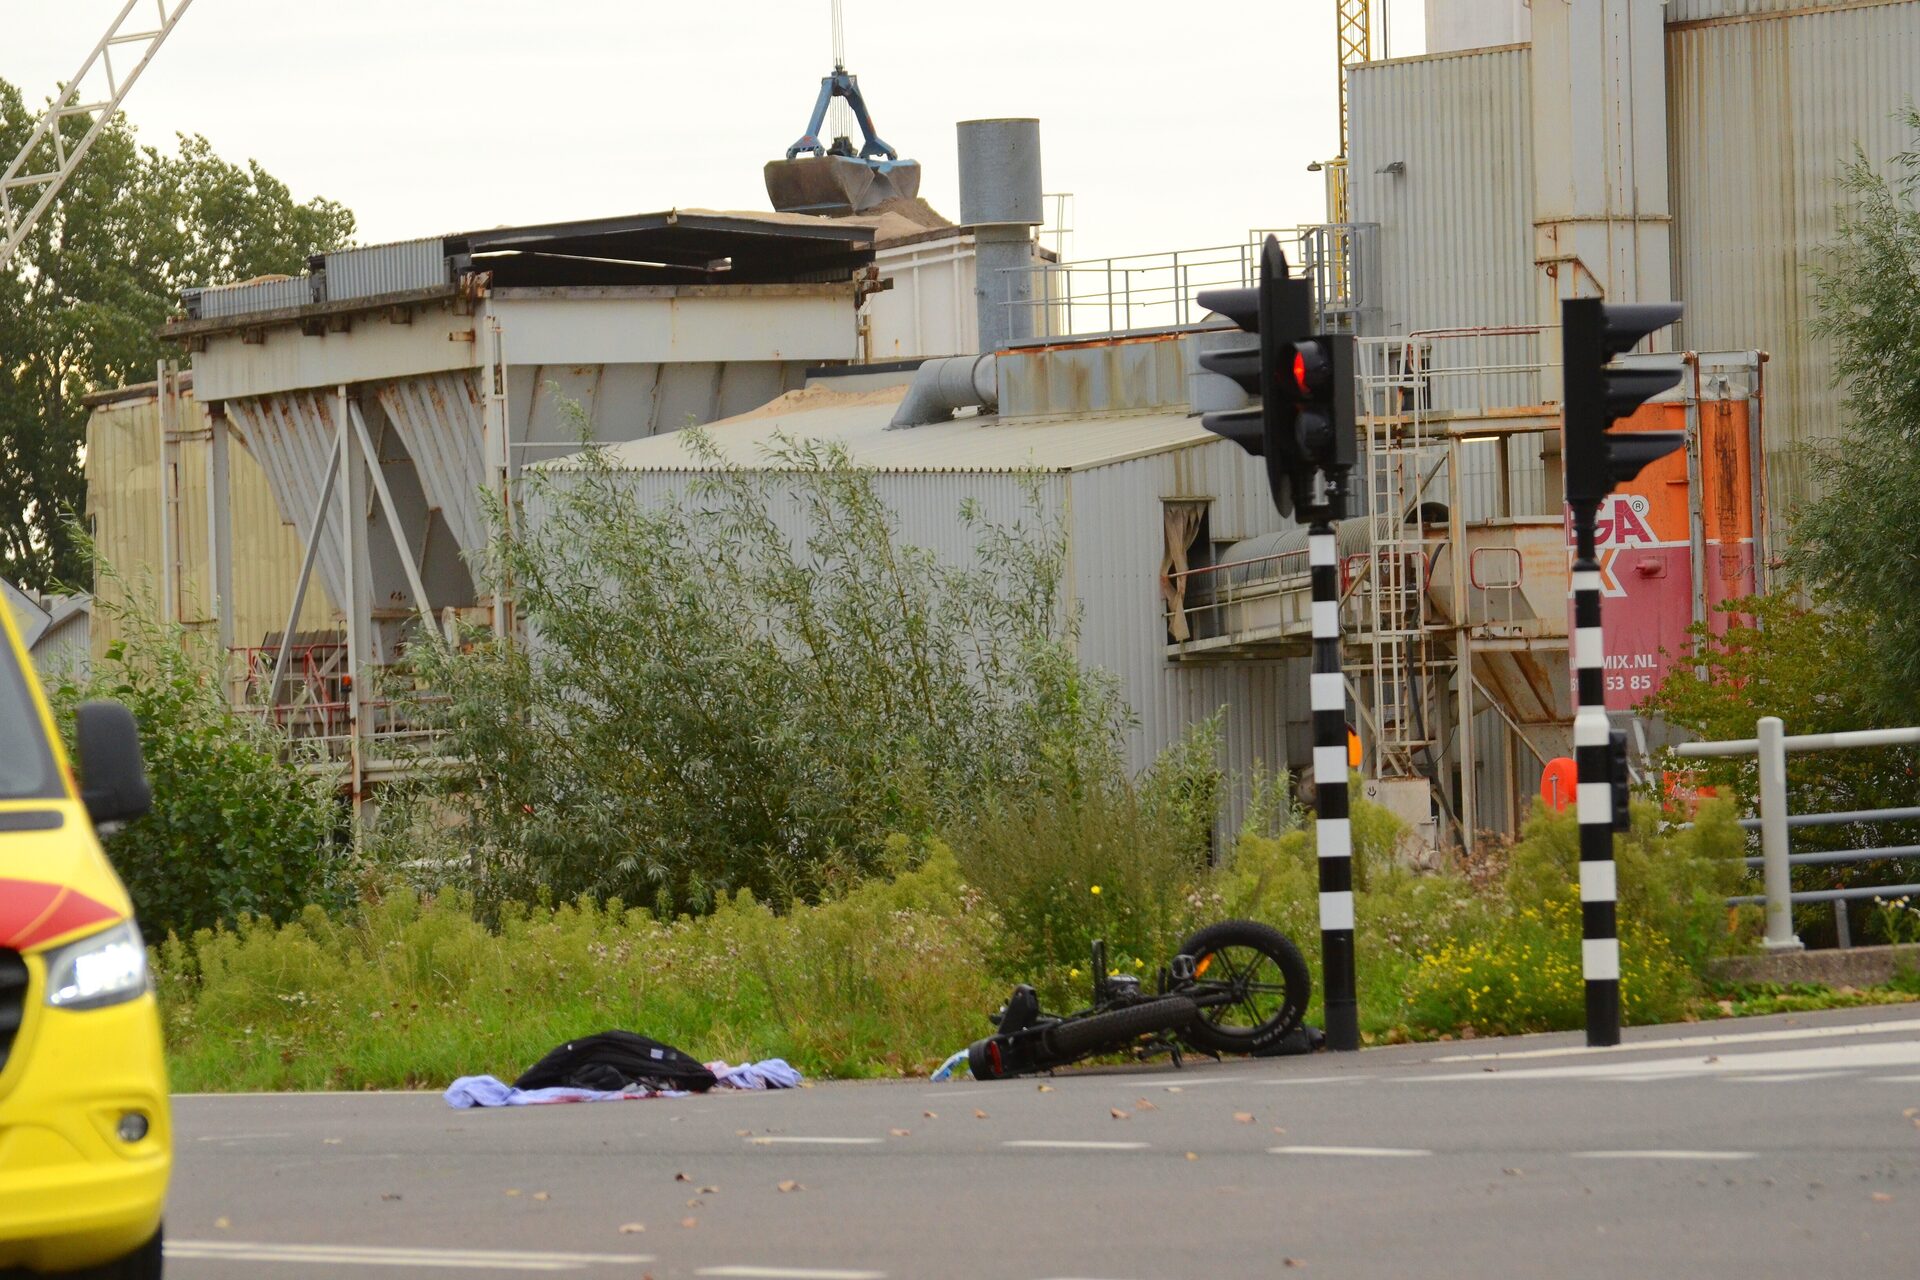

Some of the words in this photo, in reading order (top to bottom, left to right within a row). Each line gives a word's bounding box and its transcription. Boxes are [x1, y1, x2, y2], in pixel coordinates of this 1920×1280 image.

[1565, 499, 1652, 547] EGA
[1569, 654, 1658, 670] MIX.NL
[1606, 676, 1625, 691] 53
[1630, 675, 1651, 690] 85
